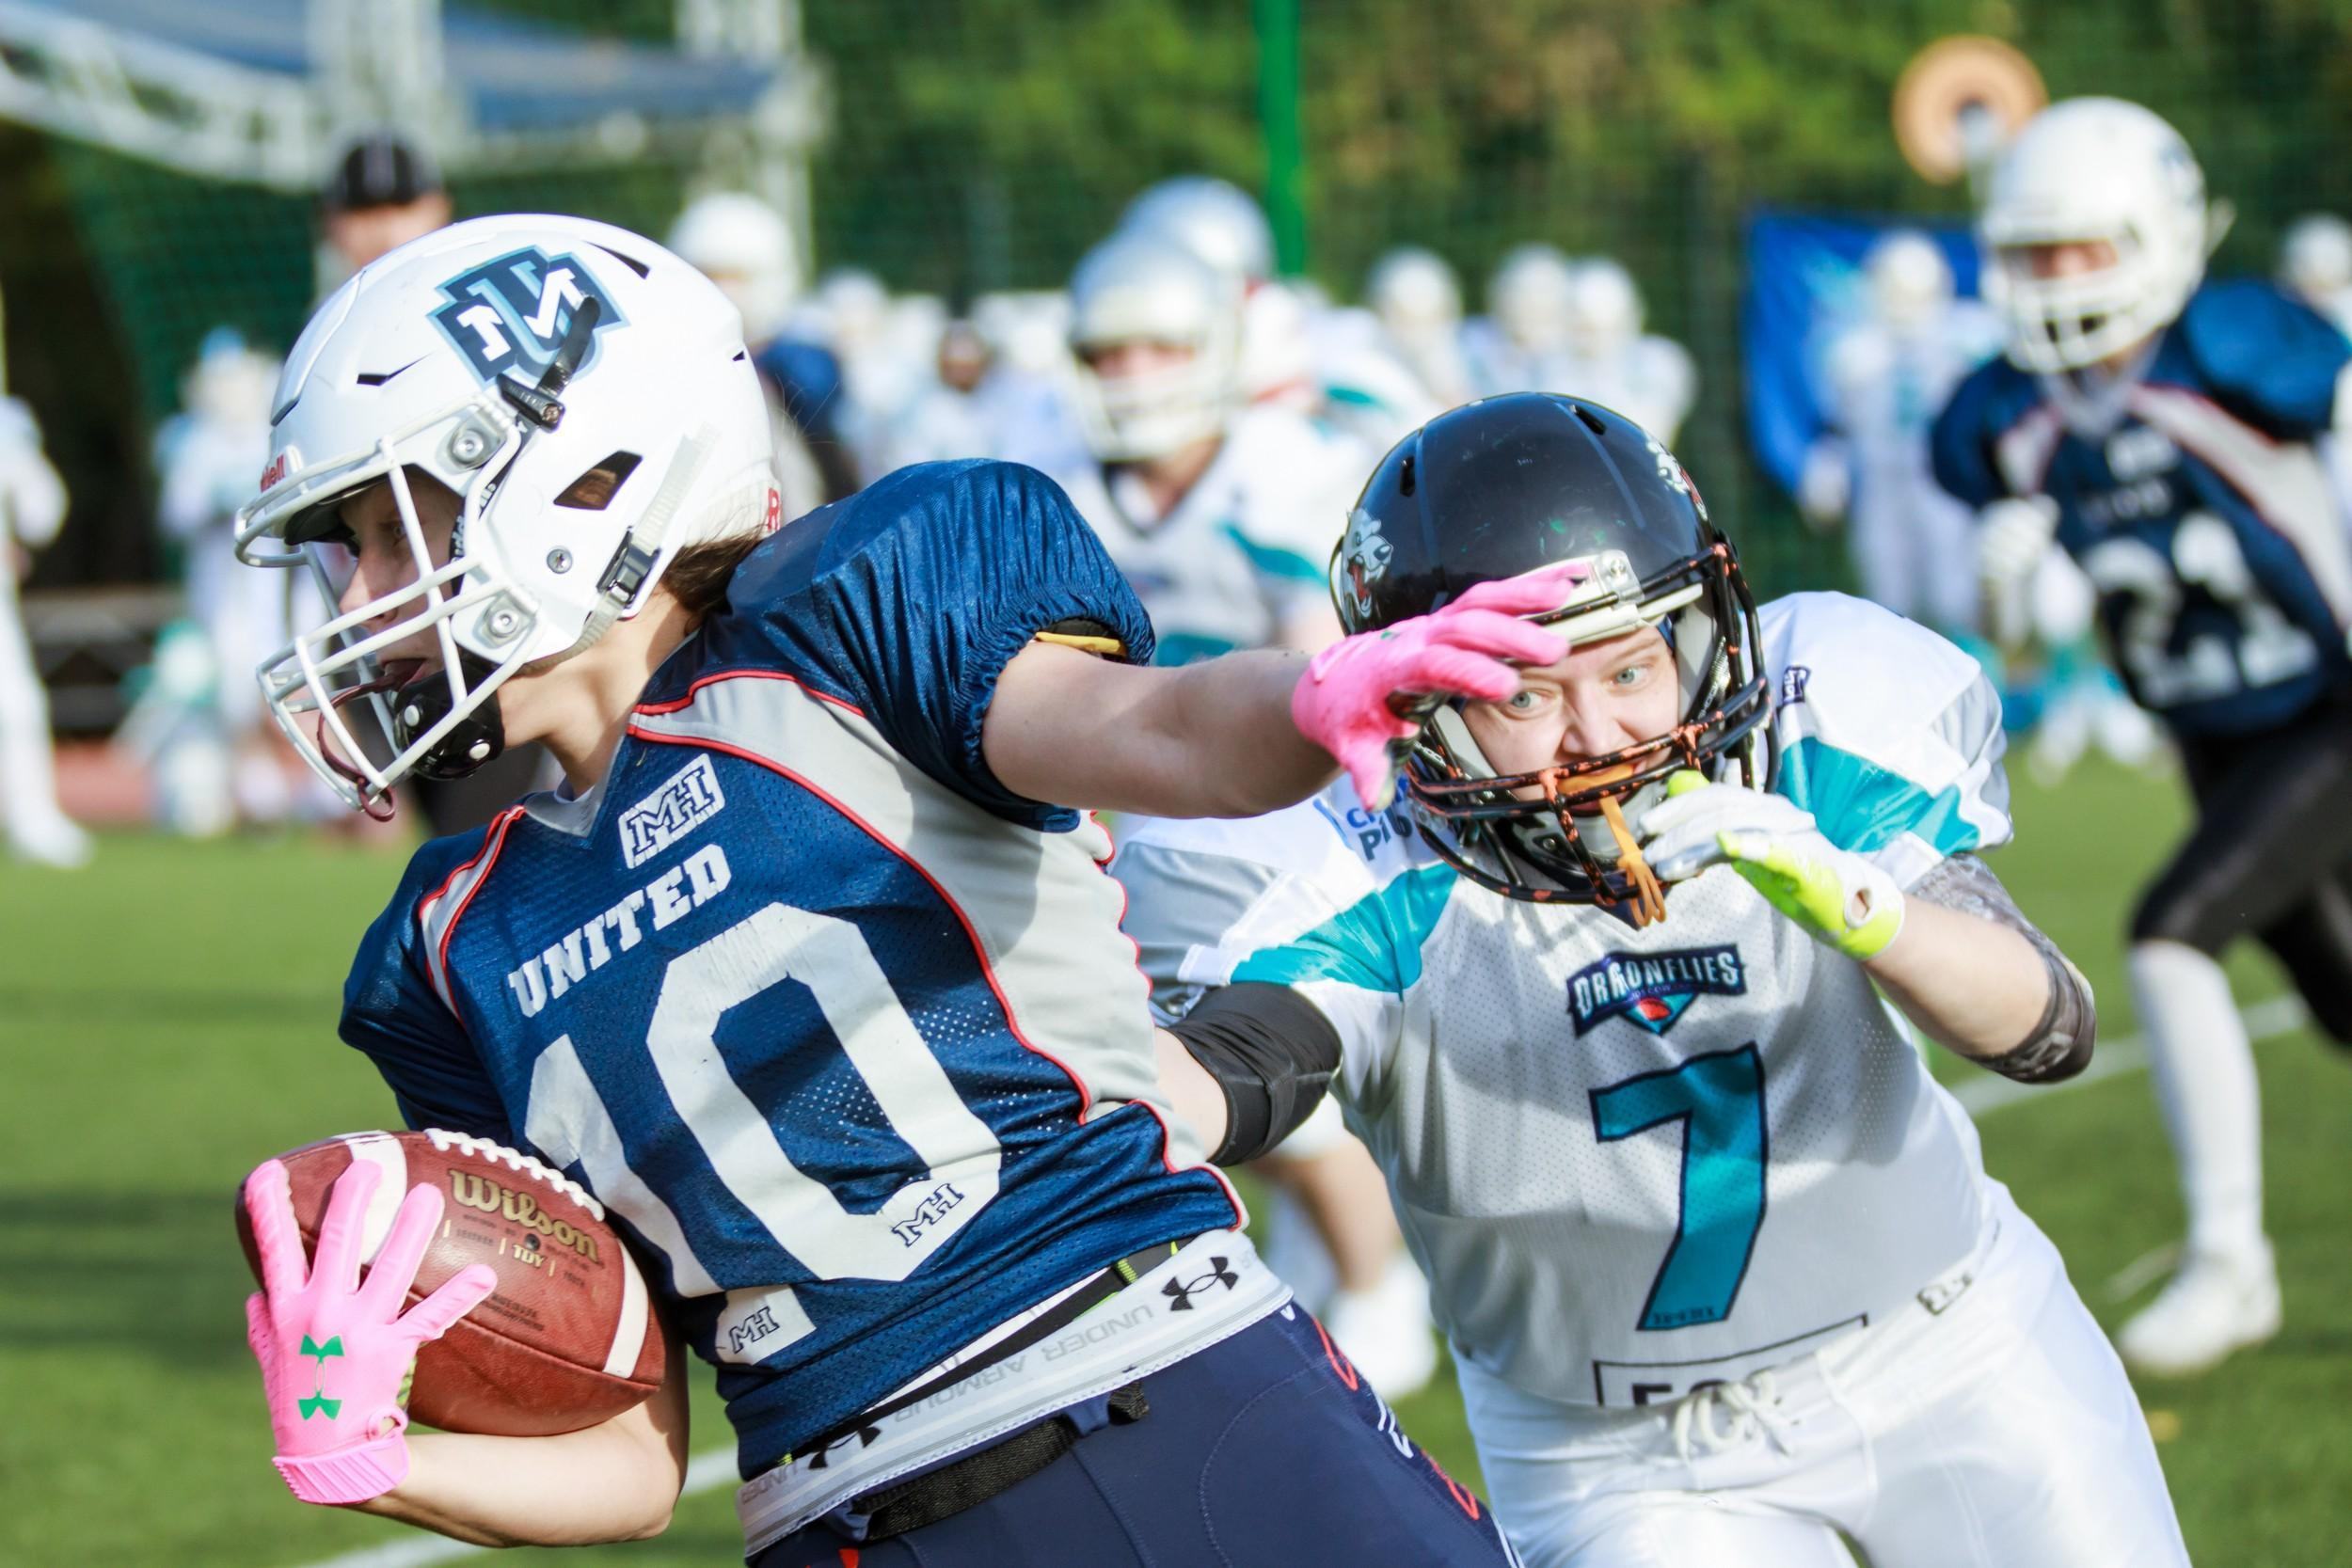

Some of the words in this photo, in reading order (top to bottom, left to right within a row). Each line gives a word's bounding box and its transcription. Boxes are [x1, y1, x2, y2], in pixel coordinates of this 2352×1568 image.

[508, 844, 732, 1018] UNITED
[1573, 951, 1740, 1020] DRAGONFLIES
[524, 901, 1002, 1364] 10
[448, 1168, 605, 1270] Wilson
[889, 1182, 964, 1248] MH
[1588, 1039, 1770, 1332] 7
[727, 1305, 779, 1354] MH
[1040, 1303, 1154, 1362] UNDER
[894, 1354, 1027, 1423] ARMOUR
